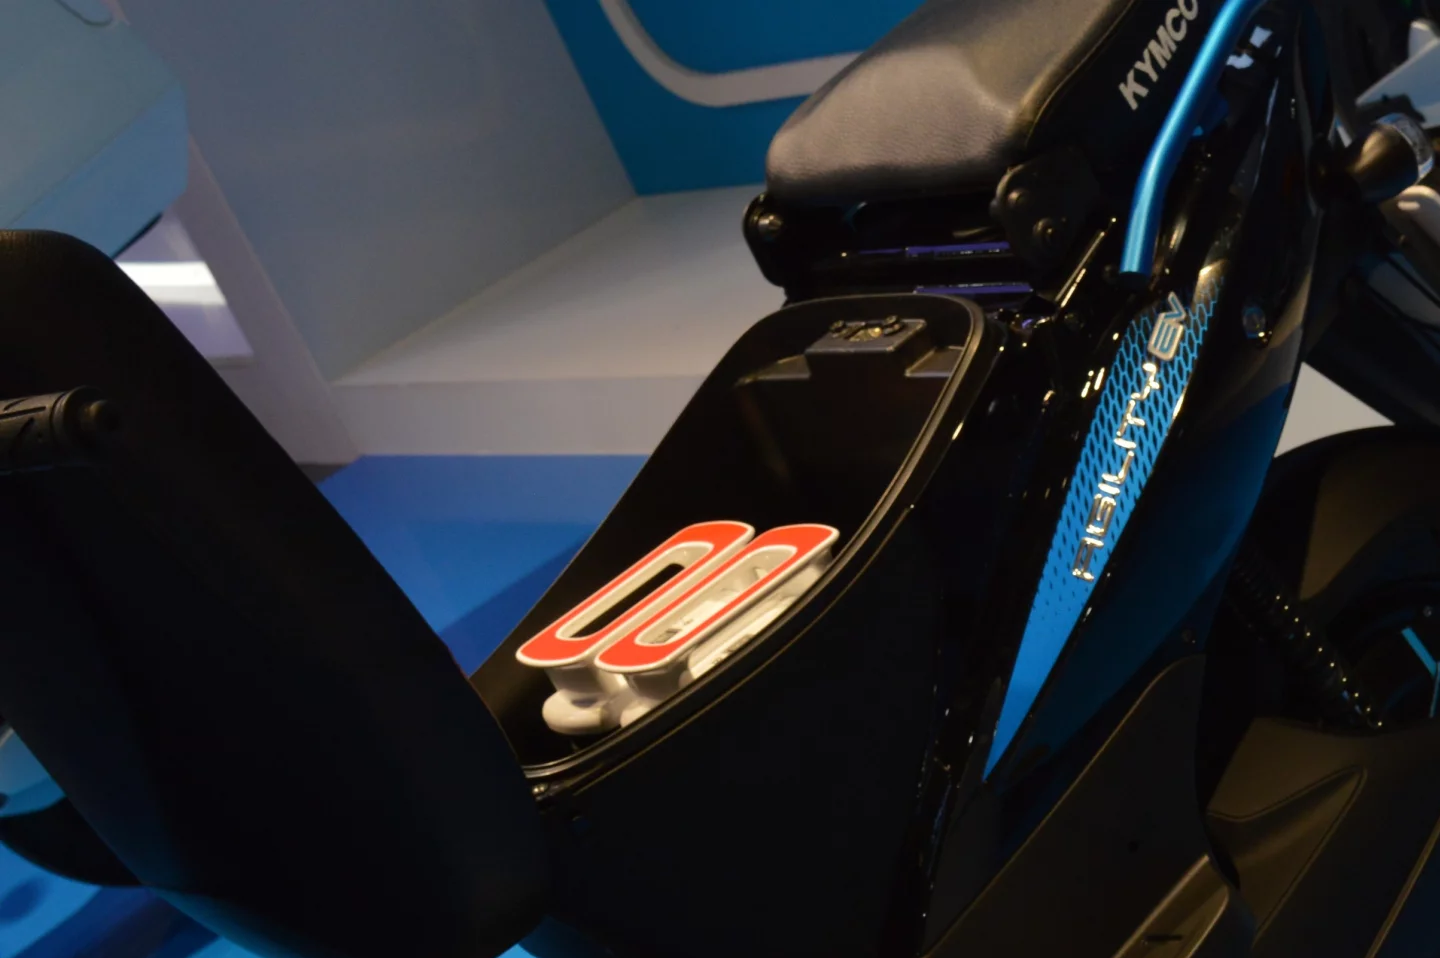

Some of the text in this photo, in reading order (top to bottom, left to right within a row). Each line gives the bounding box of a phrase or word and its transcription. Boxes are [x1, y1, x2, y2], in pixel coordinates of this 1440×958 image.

[1118, 0, 1199, 111] KYMCO
[1072, 291, 1187, 582] AGILITY EV
